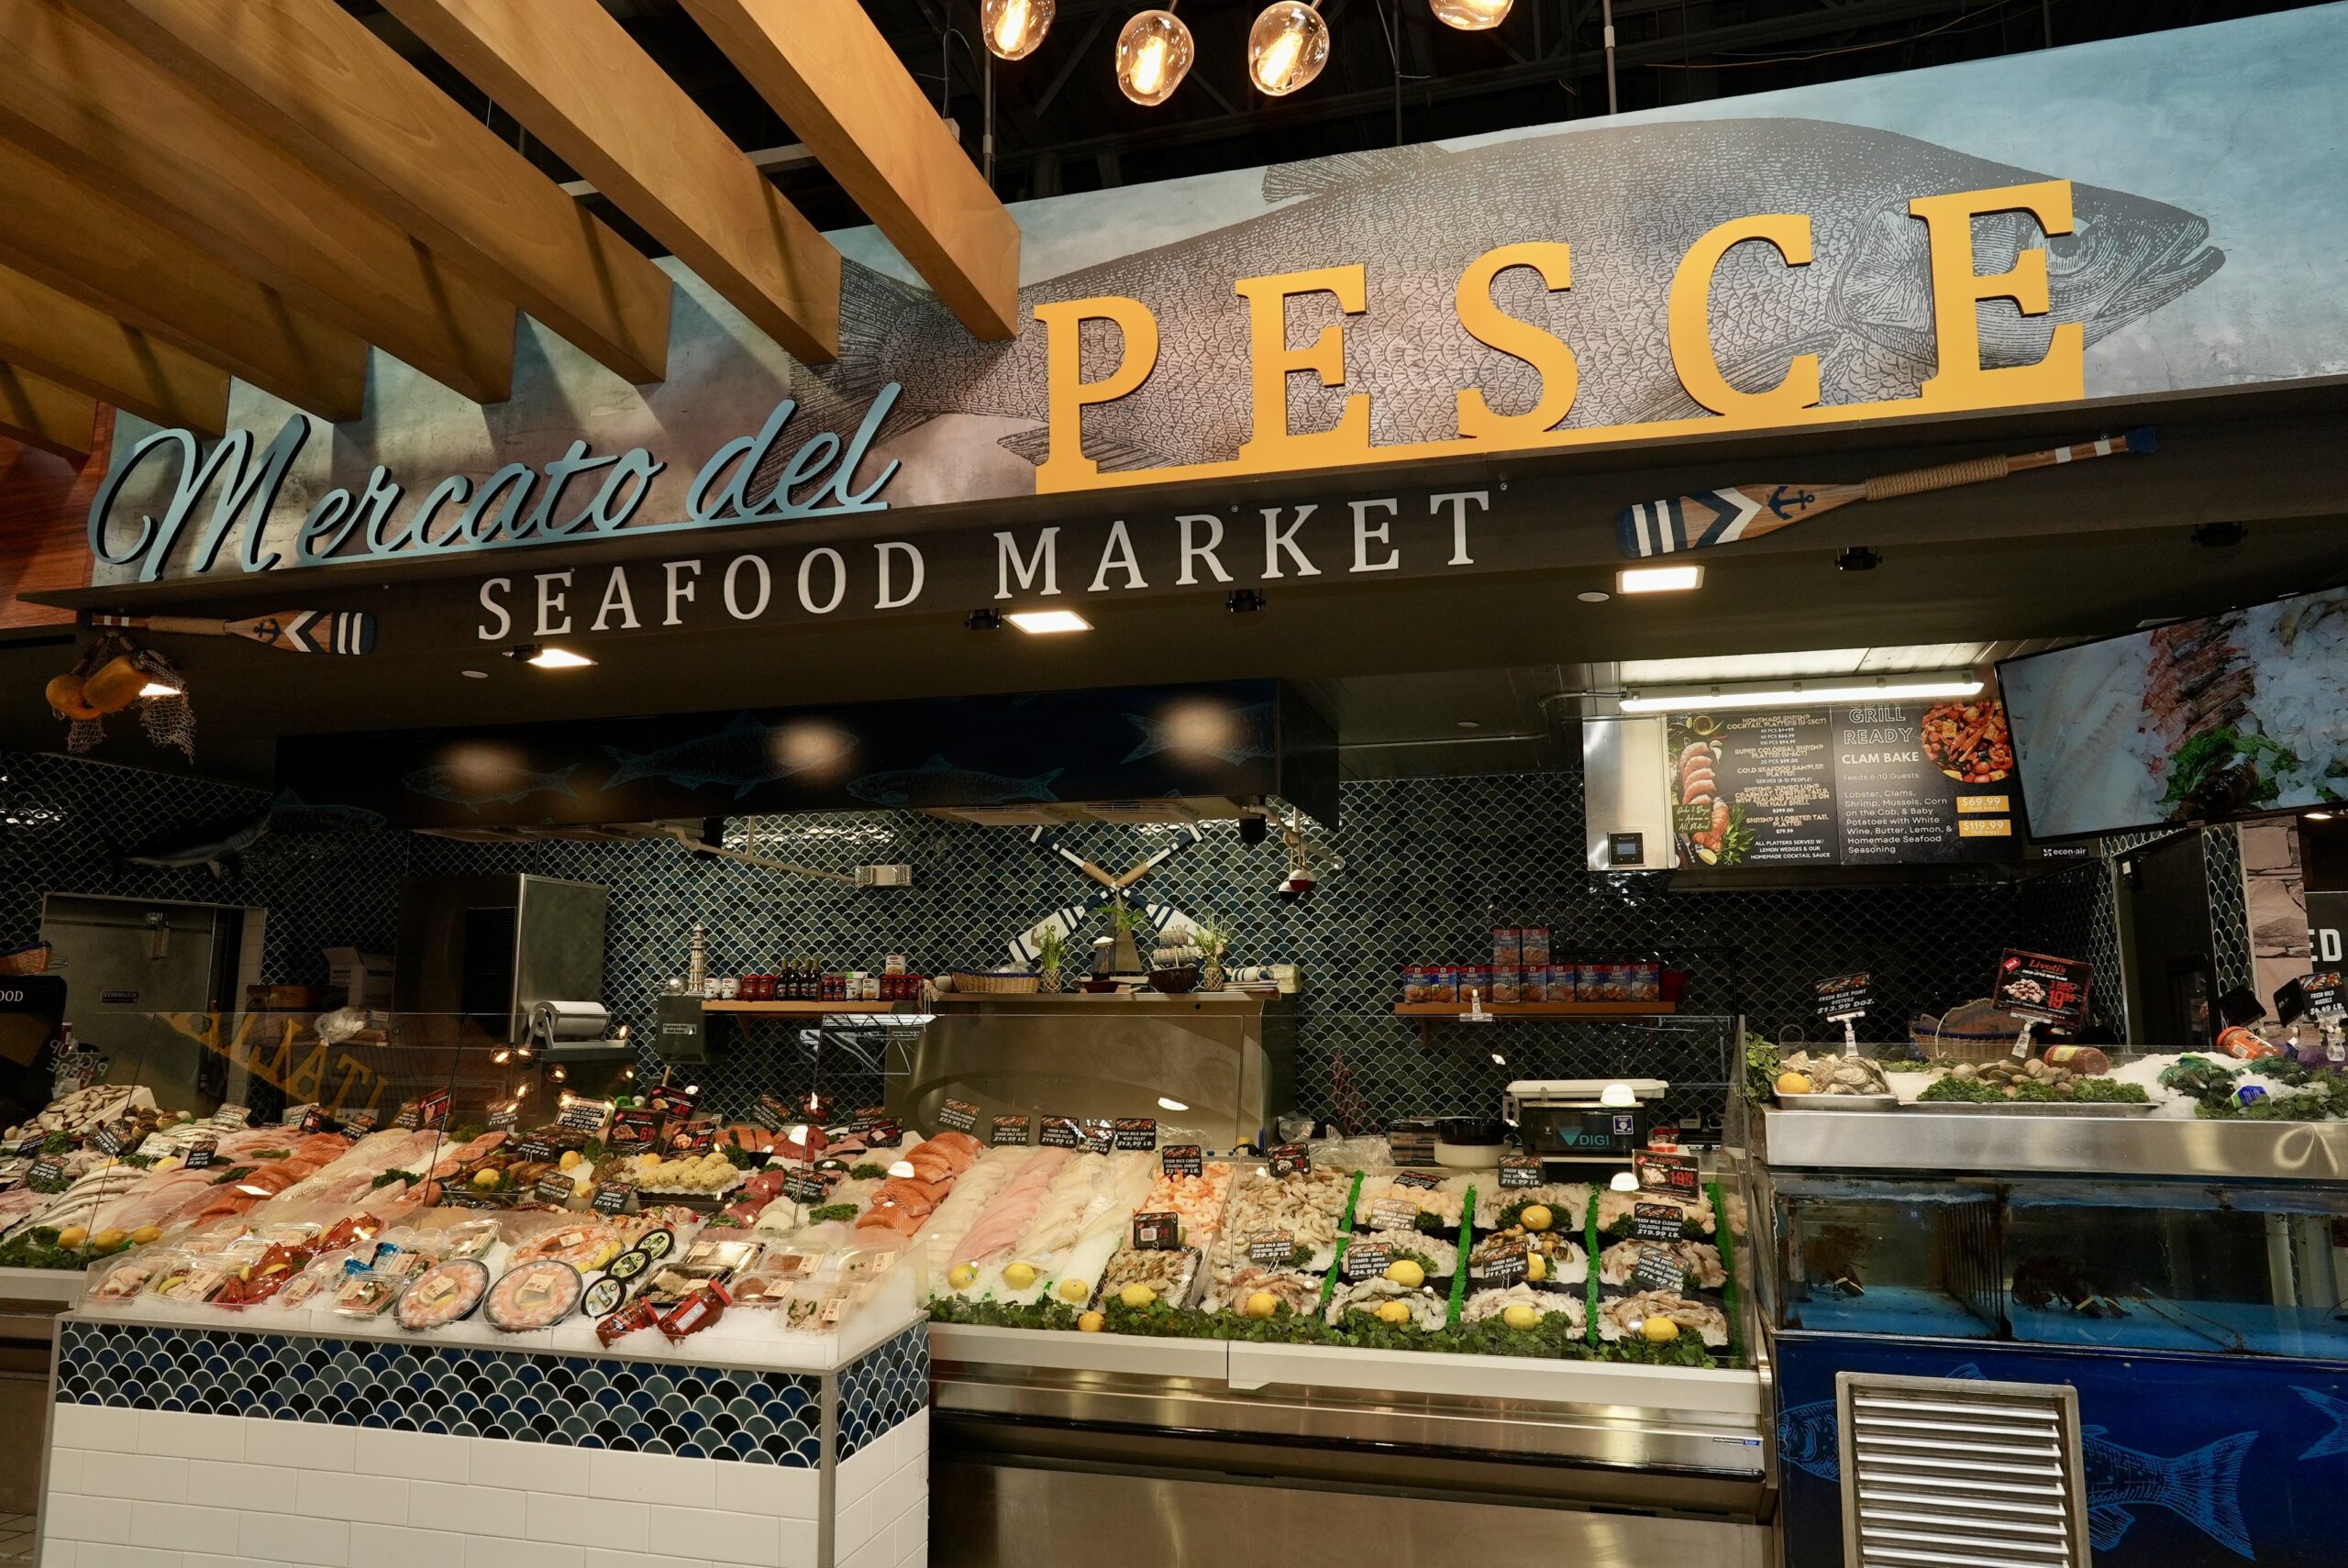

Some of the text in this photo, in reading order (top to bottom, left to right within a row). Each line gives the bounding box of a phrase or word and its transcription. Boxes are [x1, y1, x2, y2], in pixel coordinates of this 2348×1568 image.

[1033, 180, 2084, 493] PESCE
[88, 382, 901, 582] Mercato del
[477, 490, 1490, 641] SEAFOOD MARKET
[1849, 707, 1906, 723] GRILL
[1844, 727, 1913, 745] READY
[1842, 752, 1920, 765] CLAM BAKE
[1962, 798, 2000, 807] $69.99
[1963, 822, 2004, 831] $119.99
[1817, 999, 1875, 1014] $13.99 DOZ.
[1832, 997, 1854, 1005] OYSTERS
[1579, 1134, 1610, 1146] DIGI
[1640, 1264, 1663, 1275] CAROLINA
